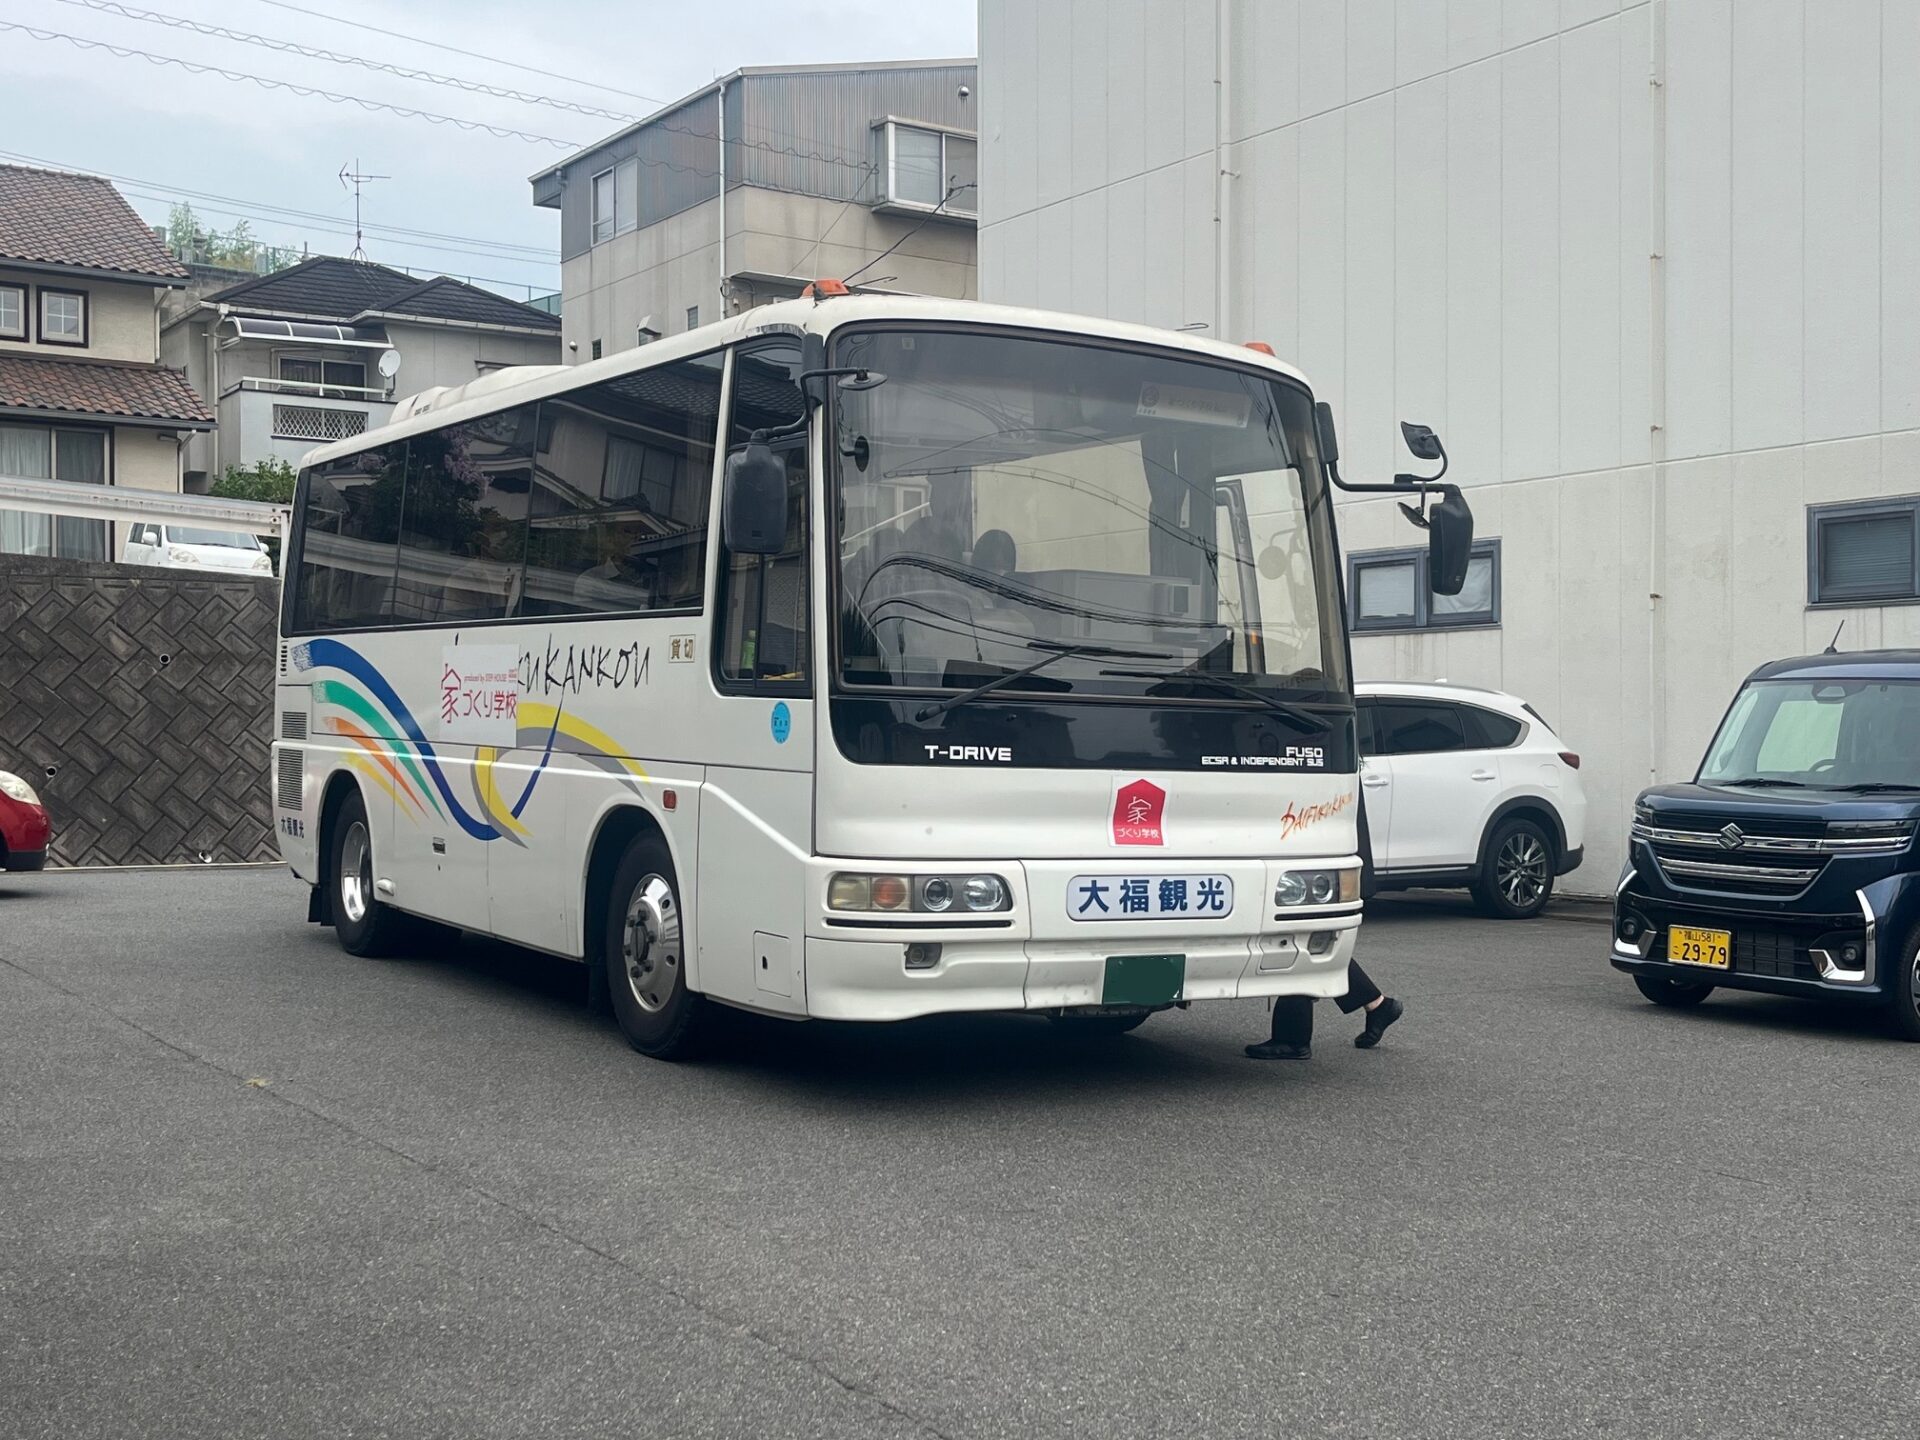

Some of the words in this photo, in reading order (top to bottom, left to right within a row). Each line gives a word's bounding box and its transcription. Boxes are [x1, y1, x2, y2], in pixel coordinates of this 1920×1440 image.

[924, 744, 1012, 761] T-DRIVE
[1286, 746, 1323, 758] FUSO
[1230, 757, 1238, 765] &
[1240, 757, 1304, 766] INDEPENDENT
[1306, 758, 1324, 767] SUS
[1127, 795, 1152, 825] 家
[1116, 827, 1160, 839] づくり学校
[1078, 877, 1225, 914] 大福観光
[1682, 942, 1727, 965] 29-79
